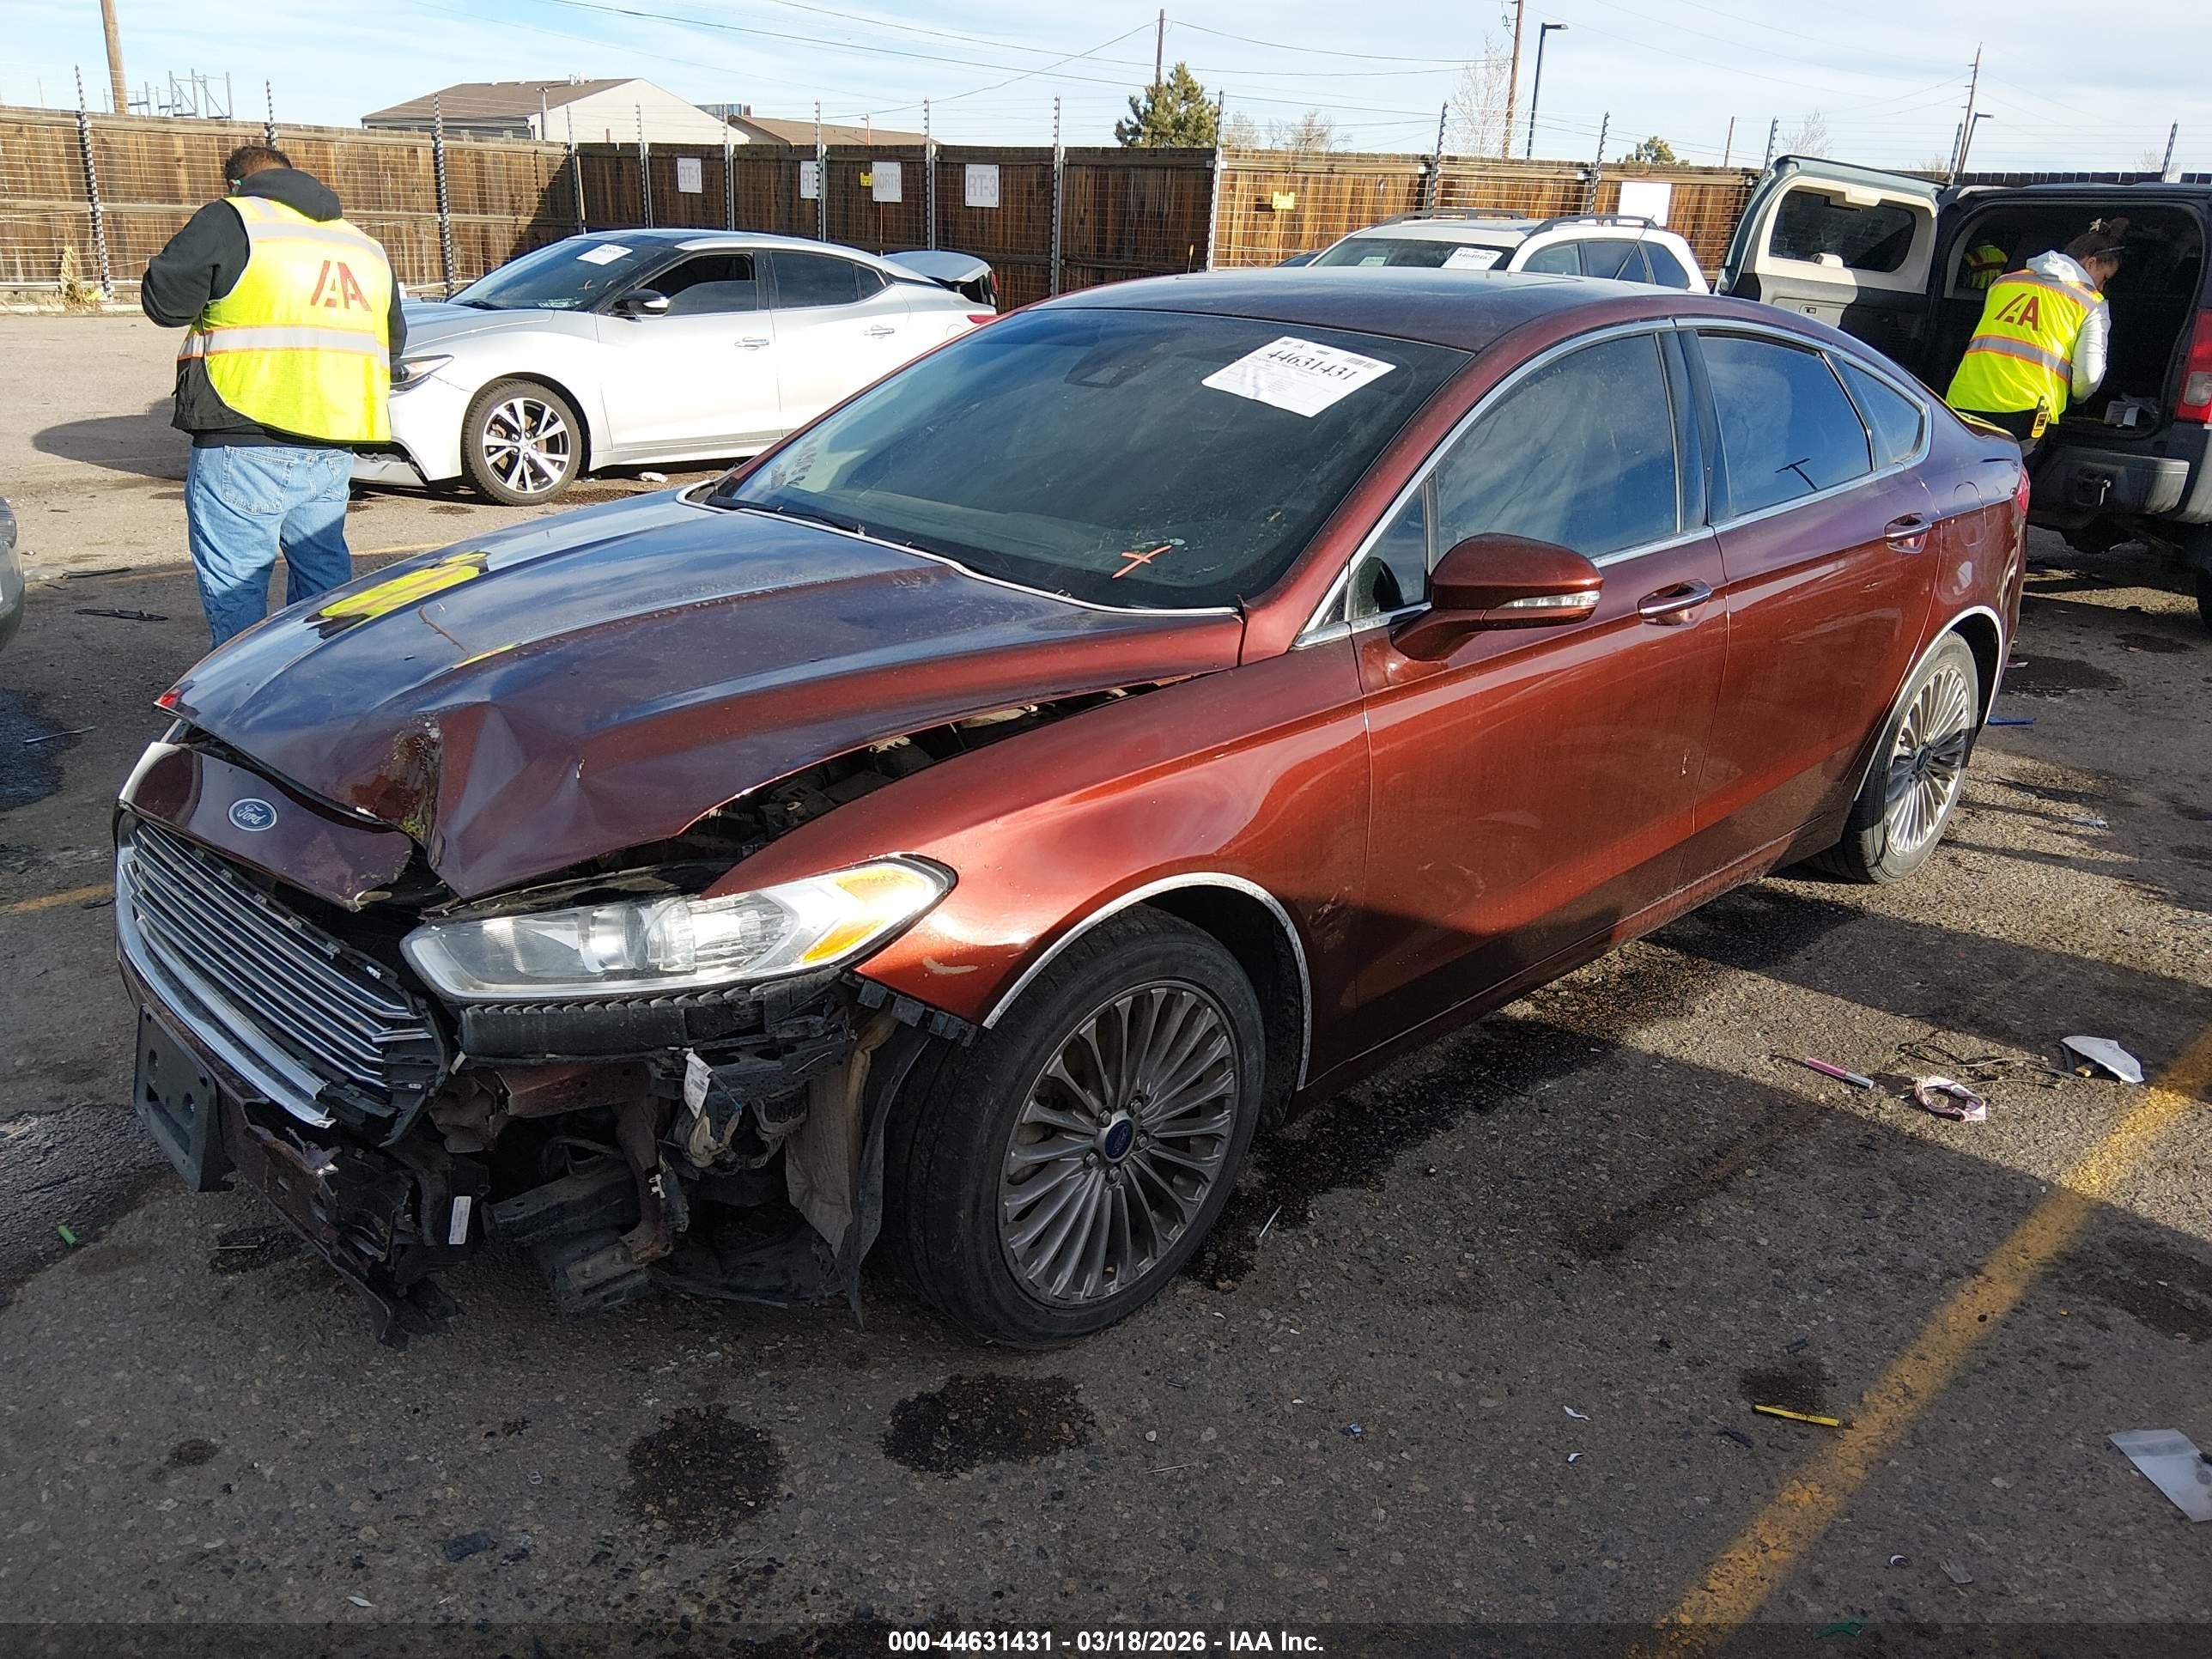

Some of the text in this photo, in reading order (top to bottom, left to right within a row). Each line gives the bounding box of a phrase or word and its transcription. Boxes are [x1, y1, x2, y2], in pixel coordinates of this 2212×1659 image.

[872, 171, 901, 190] NORTH
[967, 173, 997, 198] RT-3
[1267, 349, 1358, 380] 44631431
[236, 804, 267, 825] Ford
